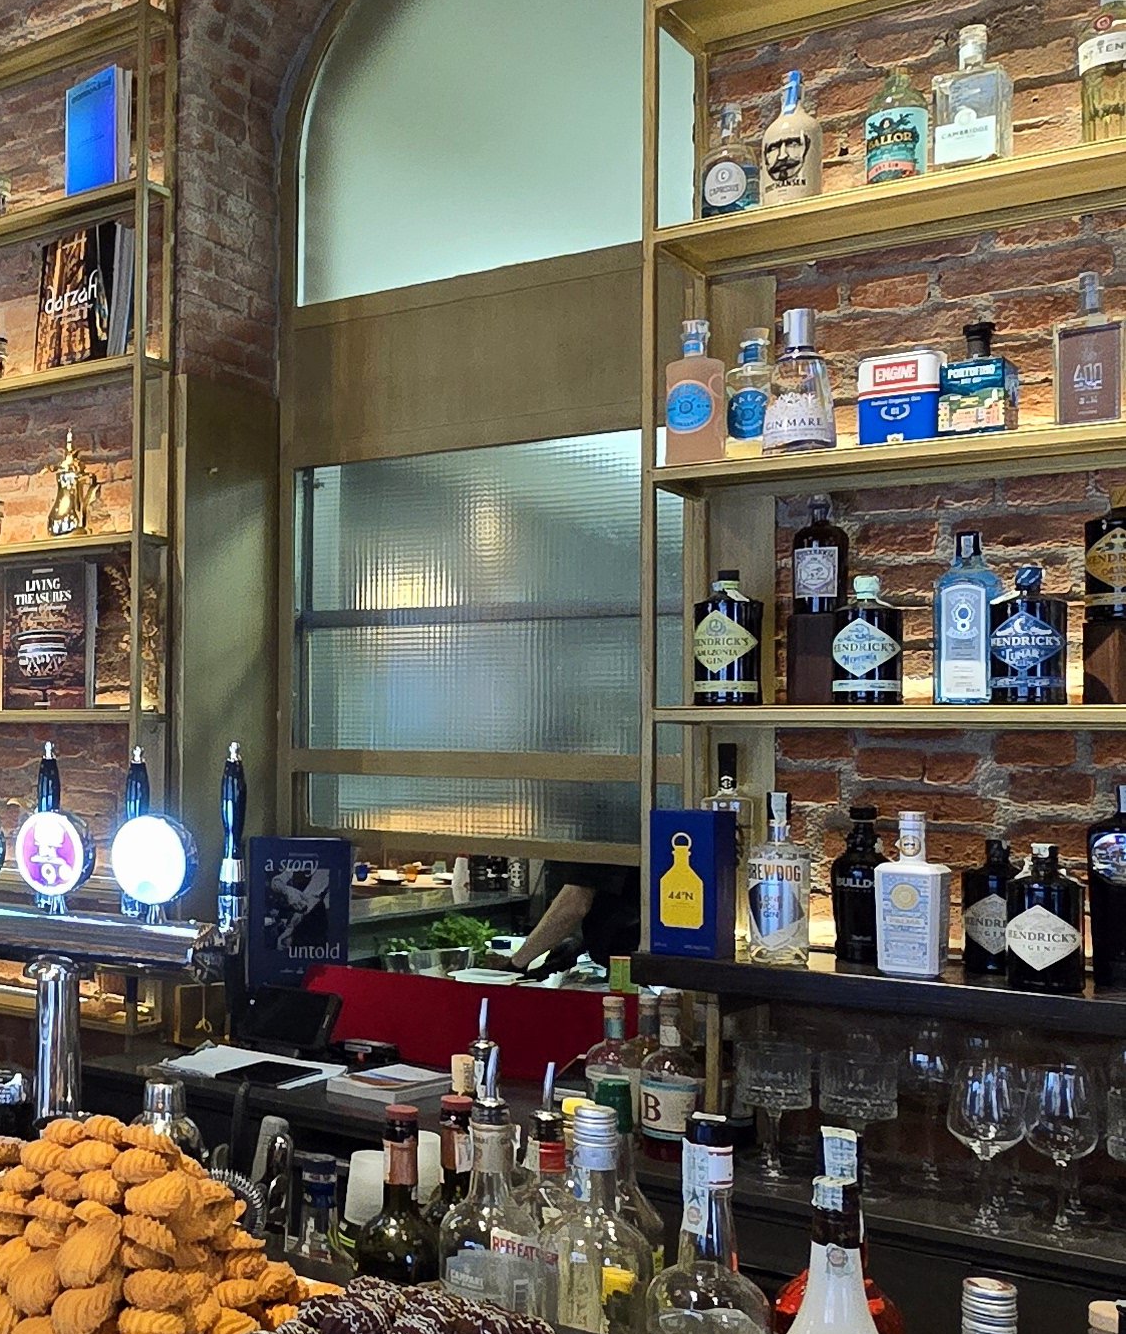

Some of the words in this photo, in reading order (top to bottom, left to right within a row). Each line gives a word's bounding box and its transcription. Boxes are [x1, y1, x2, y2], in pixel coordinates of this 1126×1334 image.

[941, 125, 989, 140] CAMBRIDGE
[875, 363, 917, 384] ENGINE
[786, 417, 824, 428] MARE
[25, 577, 61, 593] LIVING
[14, 589, 72, 606] TREASURES
[706, 657, 723, 665] GIN
[264, 858, 275, 873] a
[278, 858, 319, 878] story
[835, 877, 874, 889] BULLD
[1007, 929, 1077, 943] HENDRICK'S
[288, 942, 340, 960] untold
